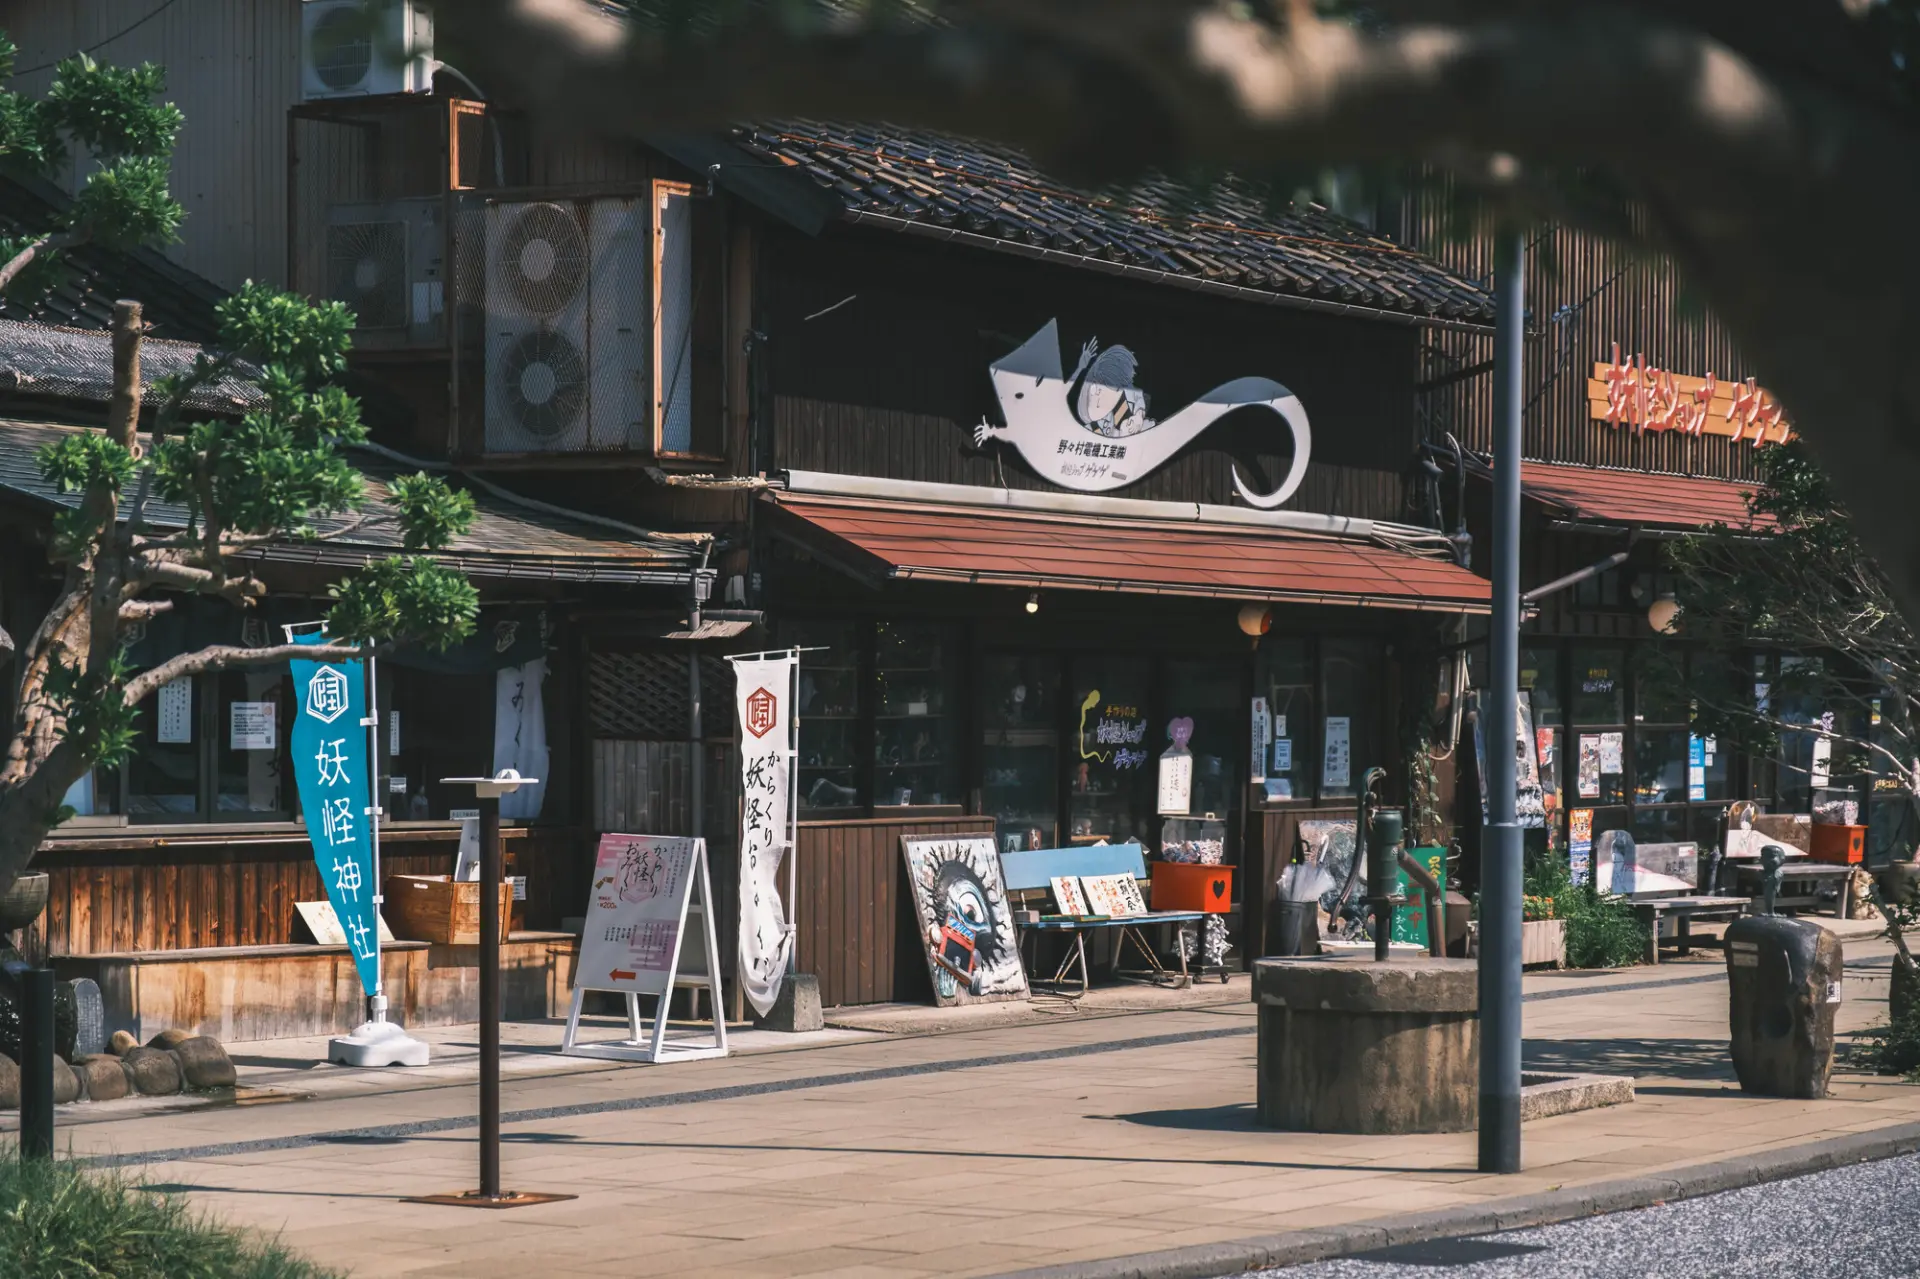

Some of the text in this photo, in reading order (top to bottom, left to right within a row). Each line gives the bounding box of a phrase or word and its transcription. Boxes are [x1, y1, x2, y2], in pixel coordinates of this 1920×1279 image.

[764, 751, 780, 847] からくり
[315, 738, 376, 961] 妖怪神社
[619, 841, 639, 902] おみくじ
[633, 851, 649, 883] 妖怪
[650, 844, 668, 898] からくり
